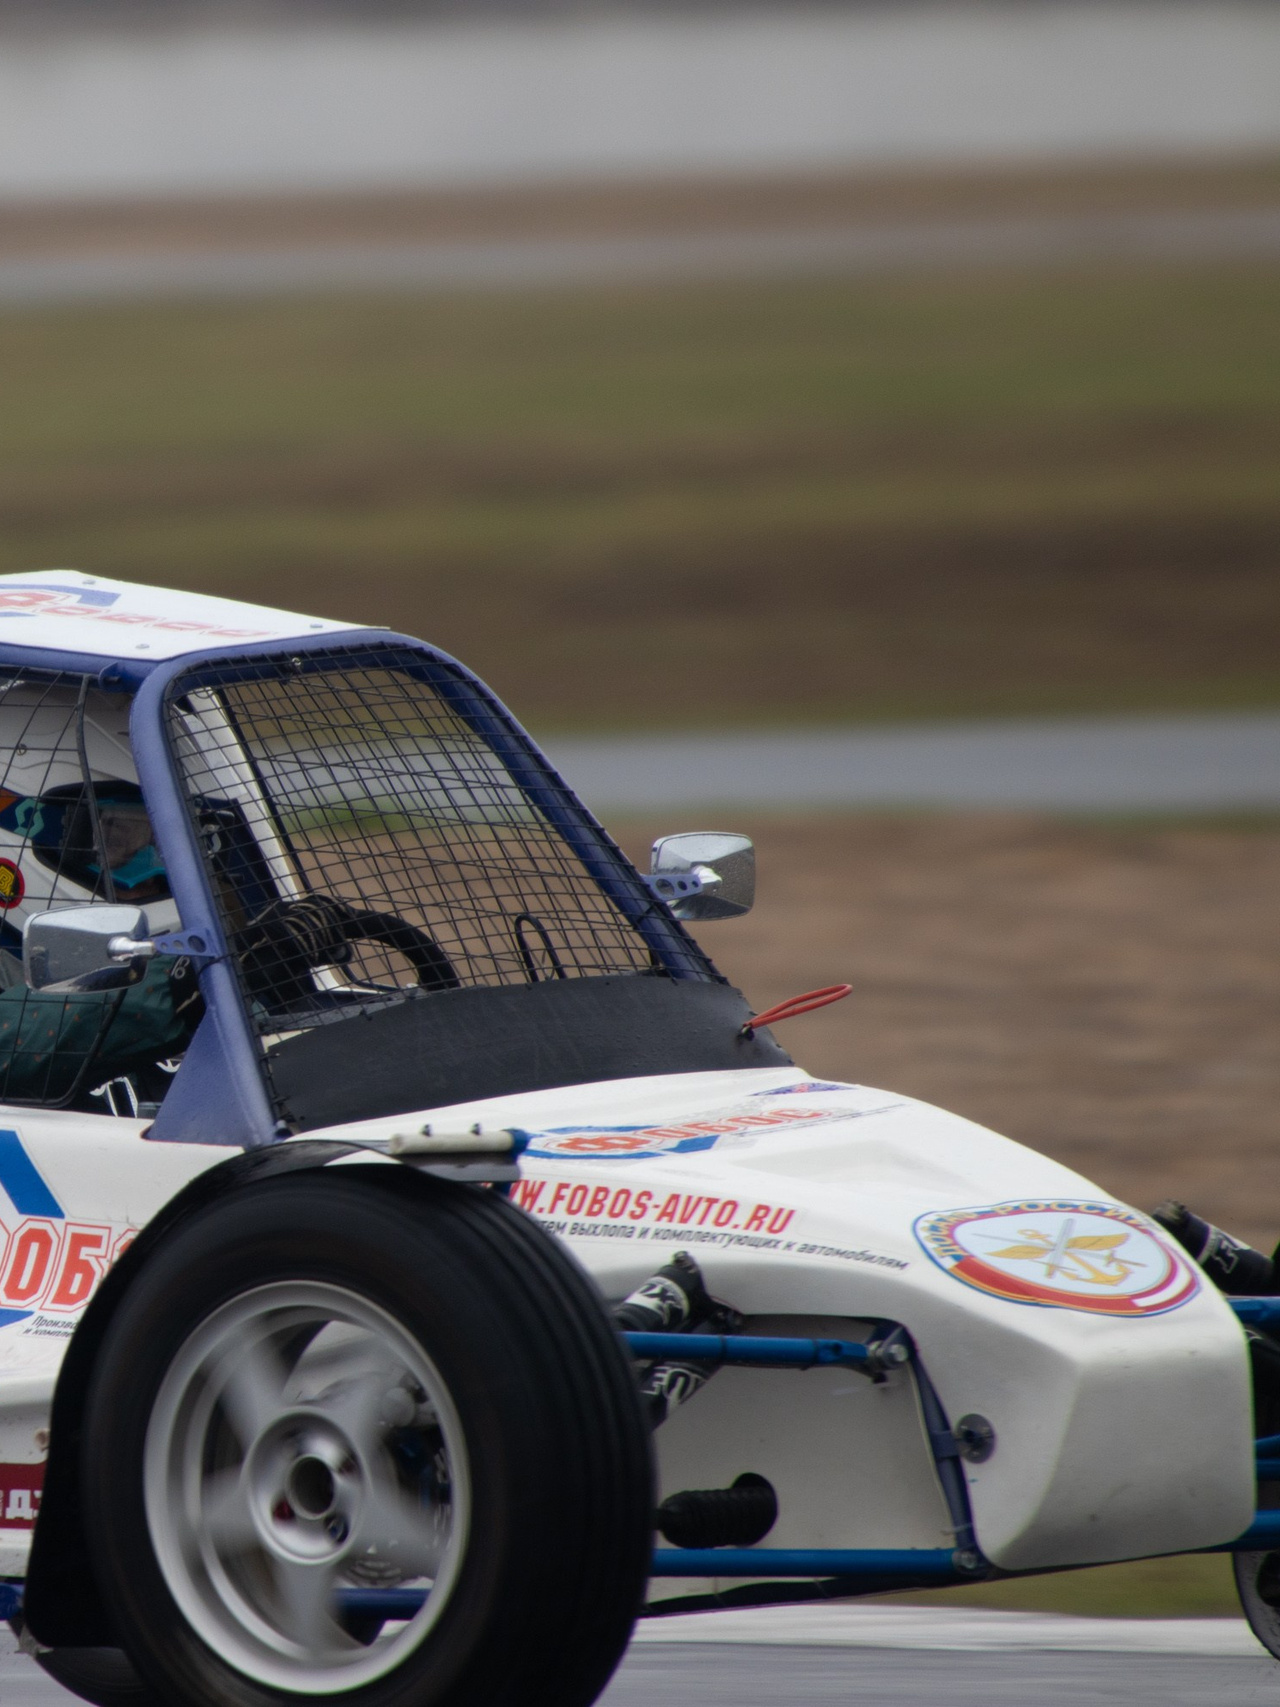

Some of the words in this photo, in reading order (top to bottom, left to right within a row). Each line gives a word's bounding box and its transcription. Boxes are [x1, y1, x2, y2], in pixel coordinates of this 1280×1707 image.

[550, 1107, 828, 1152] ФОБОС
[509, 1180, 795, 1234] W.FOBOS-AVTO.RU
[569, 1222, 635, 1238] выхлопа
[637, 1227, 650, 1239] и
[651, 1227, 780, 1248] комплектующих
[783, 1241, 798, 1251] к
[798, 1242, 910, 1270] автомобилям
